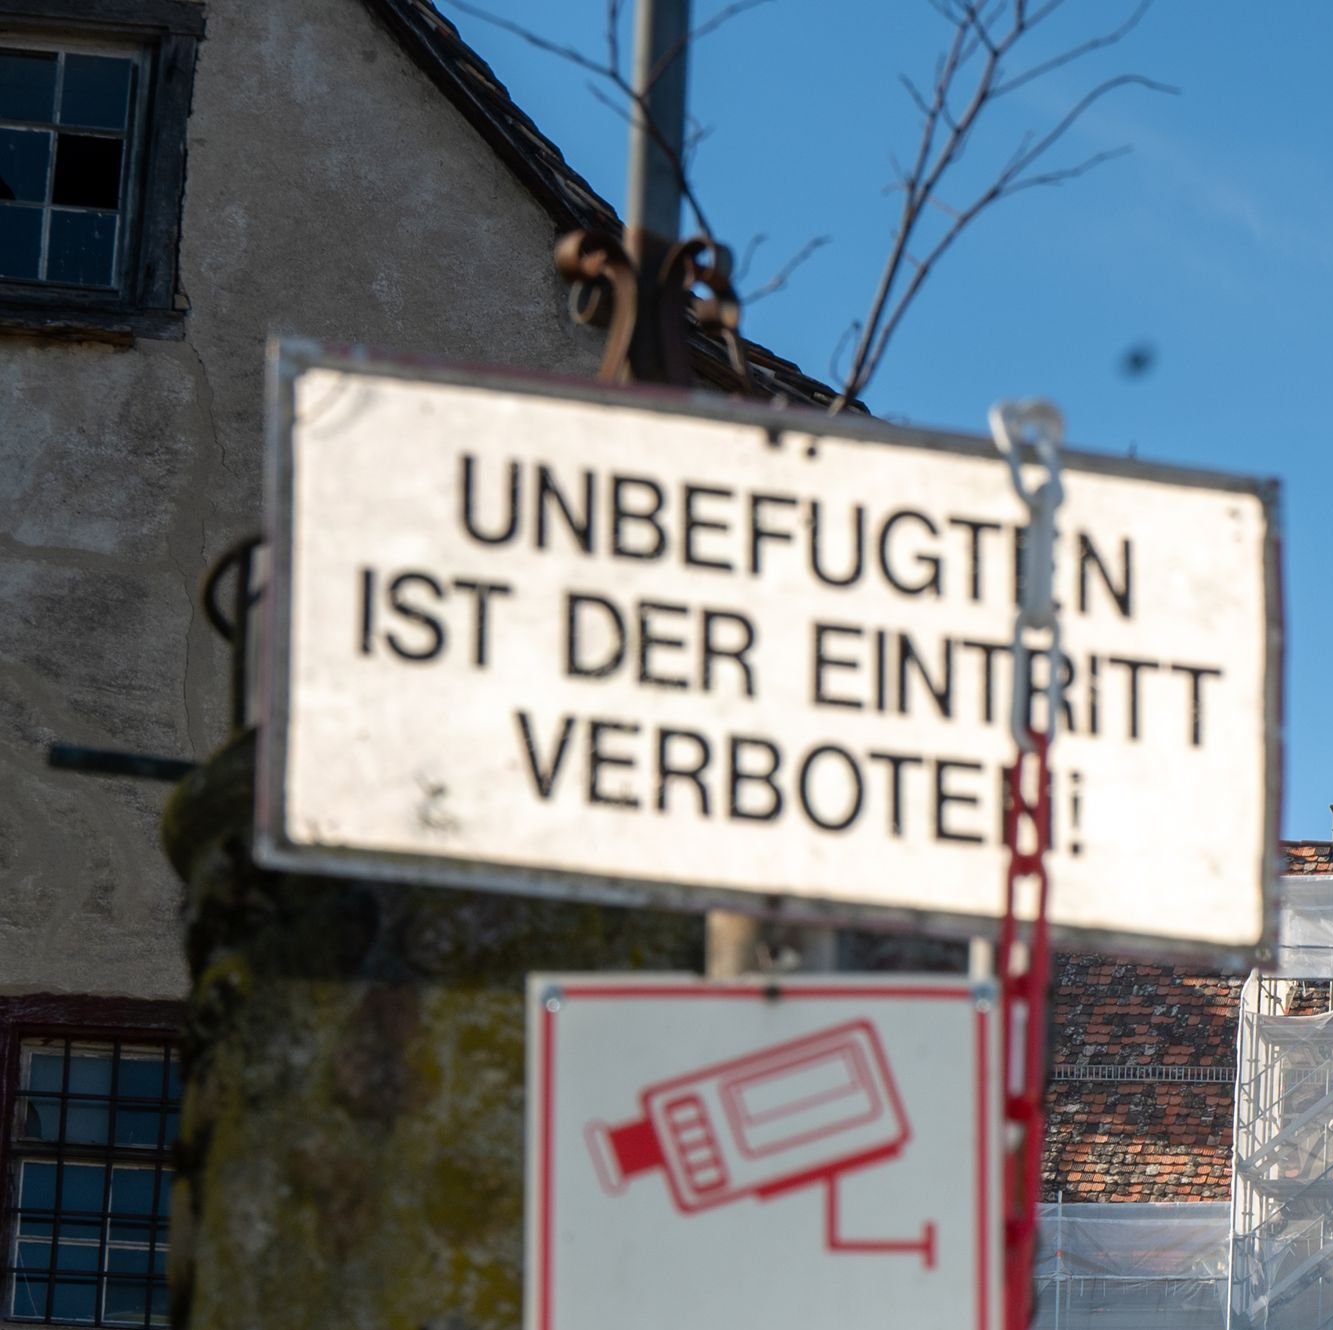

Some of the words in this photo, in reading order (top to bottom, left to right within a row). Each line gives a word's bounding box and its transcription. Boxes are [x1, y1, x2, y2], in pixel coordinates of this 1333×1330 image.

[358, 566, 514, 669] IST
[564, 590, 757, 699] DER
[812, 621, 1223, 748] EINTRITT
